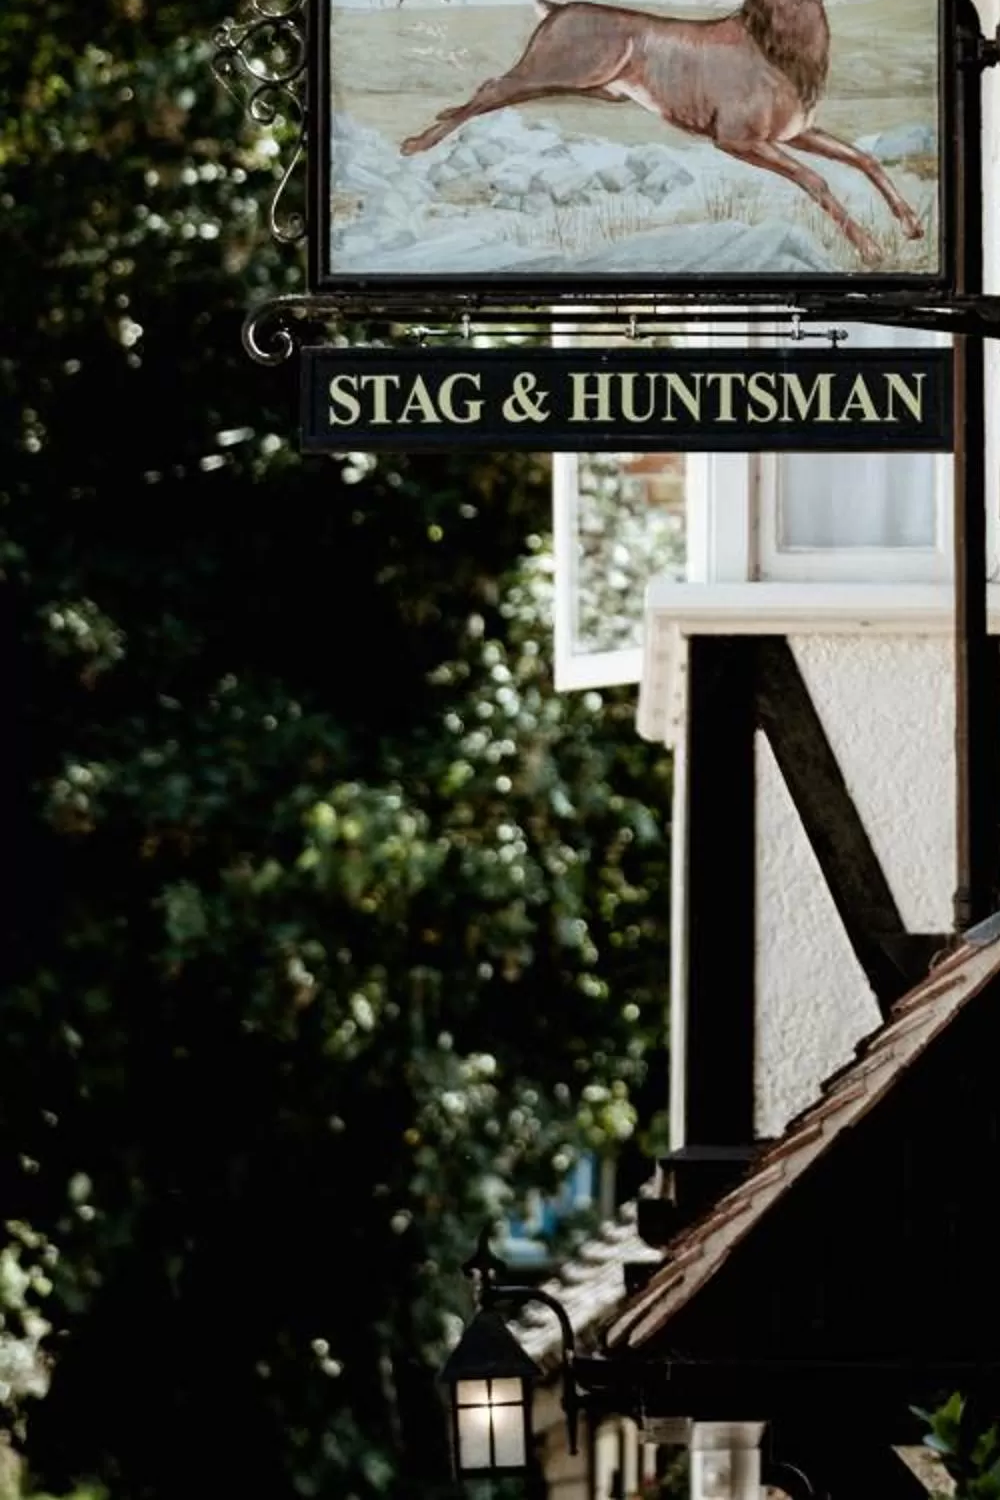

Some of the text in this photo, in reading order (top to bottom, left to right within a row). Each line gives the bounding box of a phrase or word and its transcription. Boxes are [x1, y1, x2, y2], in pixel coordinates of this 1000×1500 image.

[329, 371, 928, 424] STAG & HUNTSMAN
